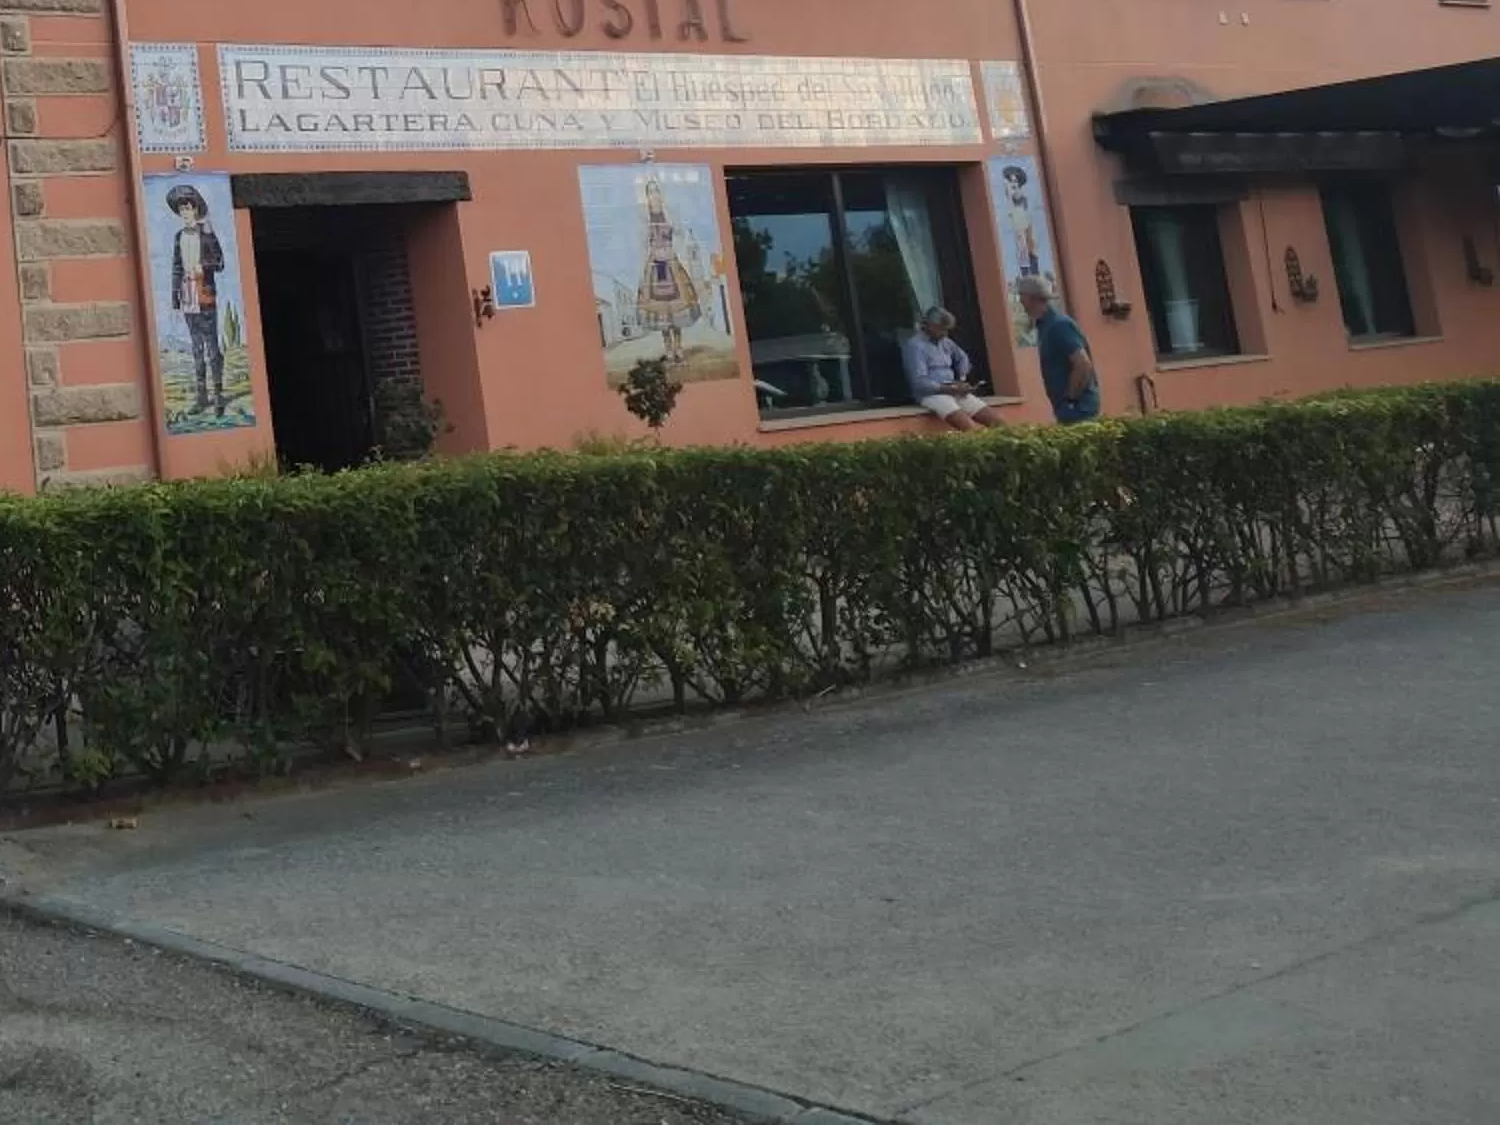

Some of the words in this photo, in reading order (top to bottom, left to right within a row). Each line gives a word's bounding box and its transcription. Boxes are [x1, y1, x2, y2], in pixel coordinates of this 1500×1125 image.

[235, 59, 616, 101] RESTAURANT
[490, 112, 585, 132] CUNA
[757, 113, 814, 130] DEL
